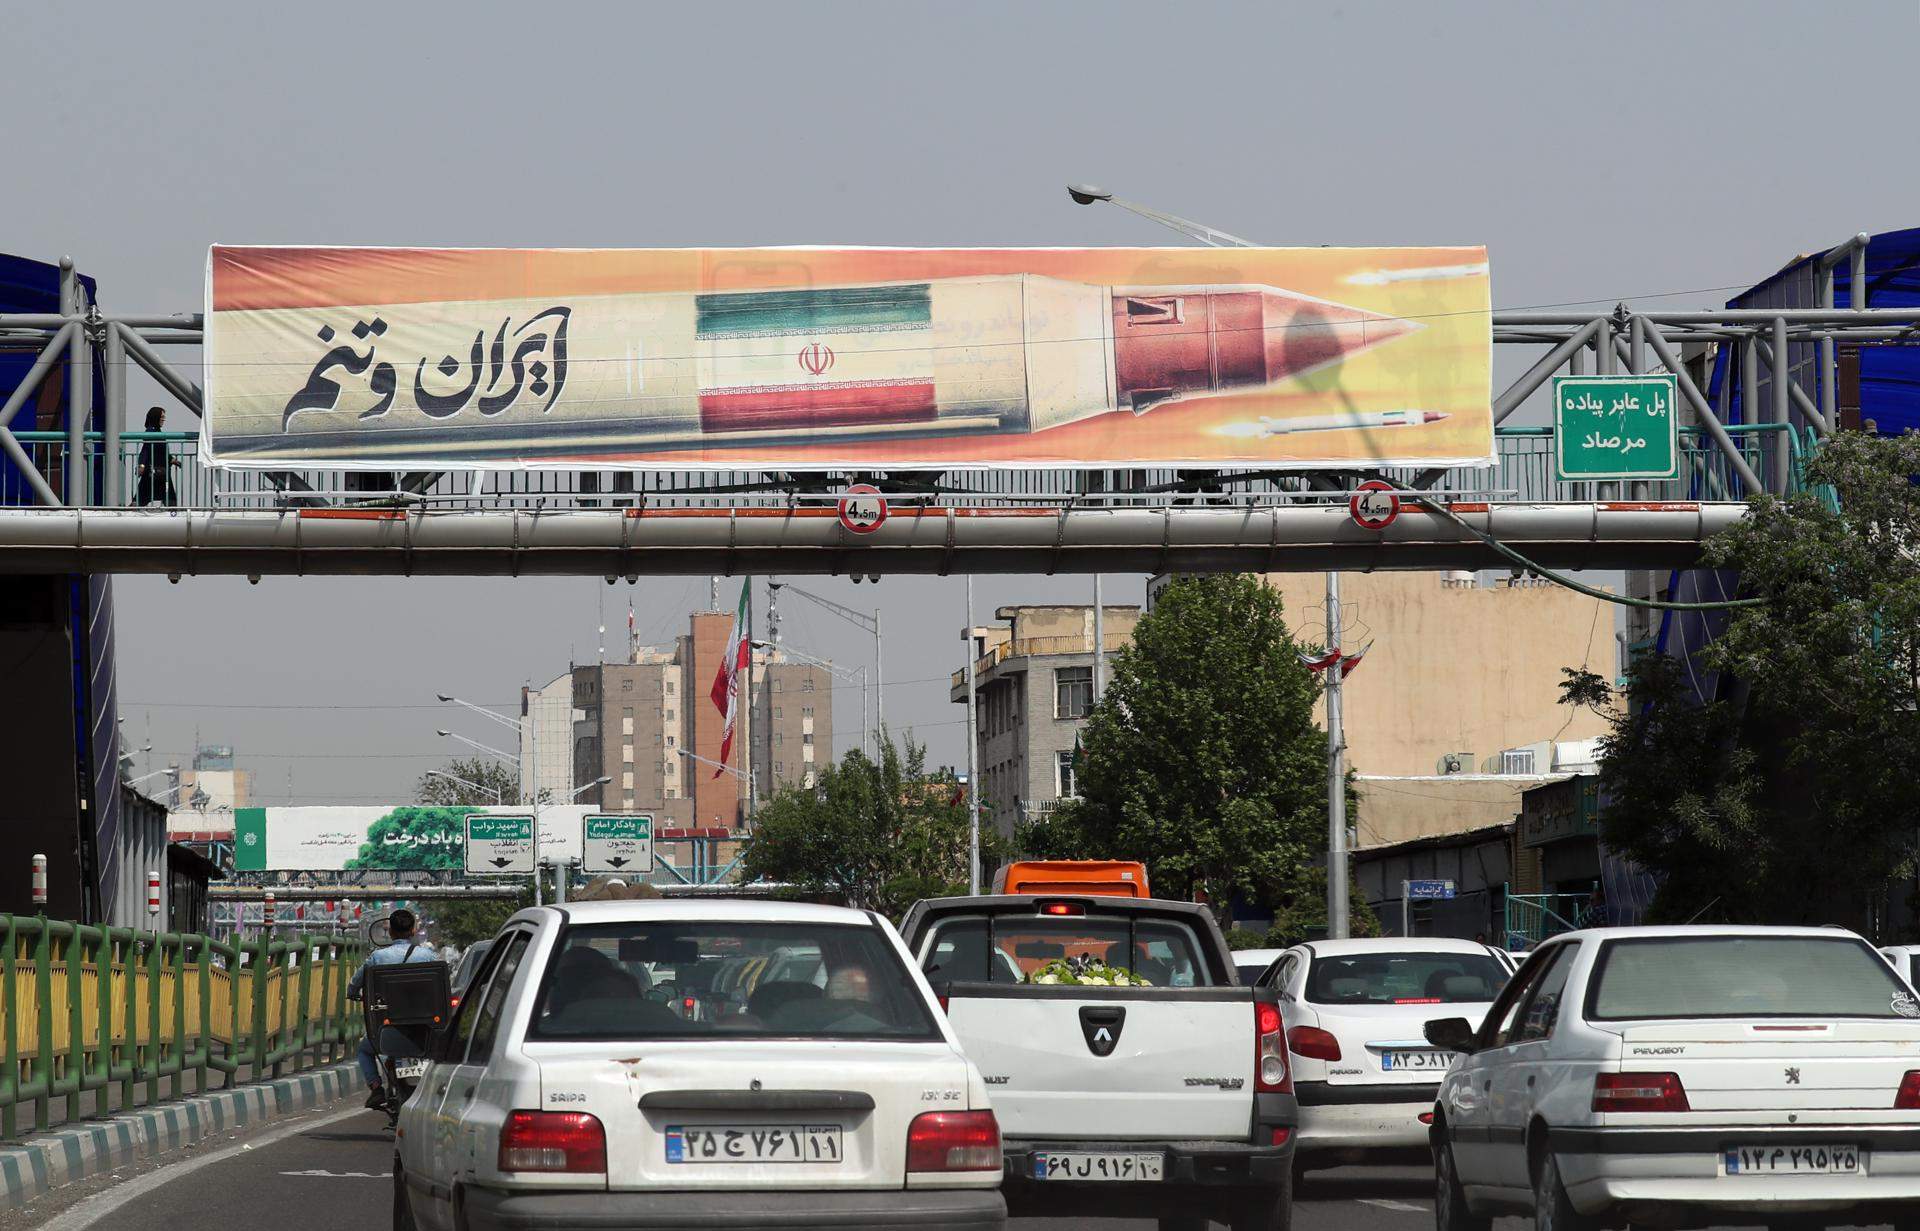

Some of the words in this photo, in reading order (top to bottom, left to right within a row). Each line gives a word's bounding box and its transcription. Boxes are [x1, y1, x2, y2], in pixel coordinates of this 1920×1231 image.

[414, 306, 572, 419] ایران
[1565, 393, 1604, 417] پیاده
[1608, 392, 1640, 416] عابر
[1646, 392, 1666, 417] پل
[1581, 432, 1647, 454] مرصاد
[848, 500, 877, 519] 4.5m
[1359, 496, 1389, 514] 4.5m
[472, 821, 495, 833] نواب
[495, 820, 519, 831] شهید
[592, 820, 610, 832] امام
[610, 820, 636, 831] یادگار
[1633, 1047, 1686, 1055] PEUGEOT
[550, 1093, 586, 1103] SAIPA
[943, 1091, 961, 1101] SE
